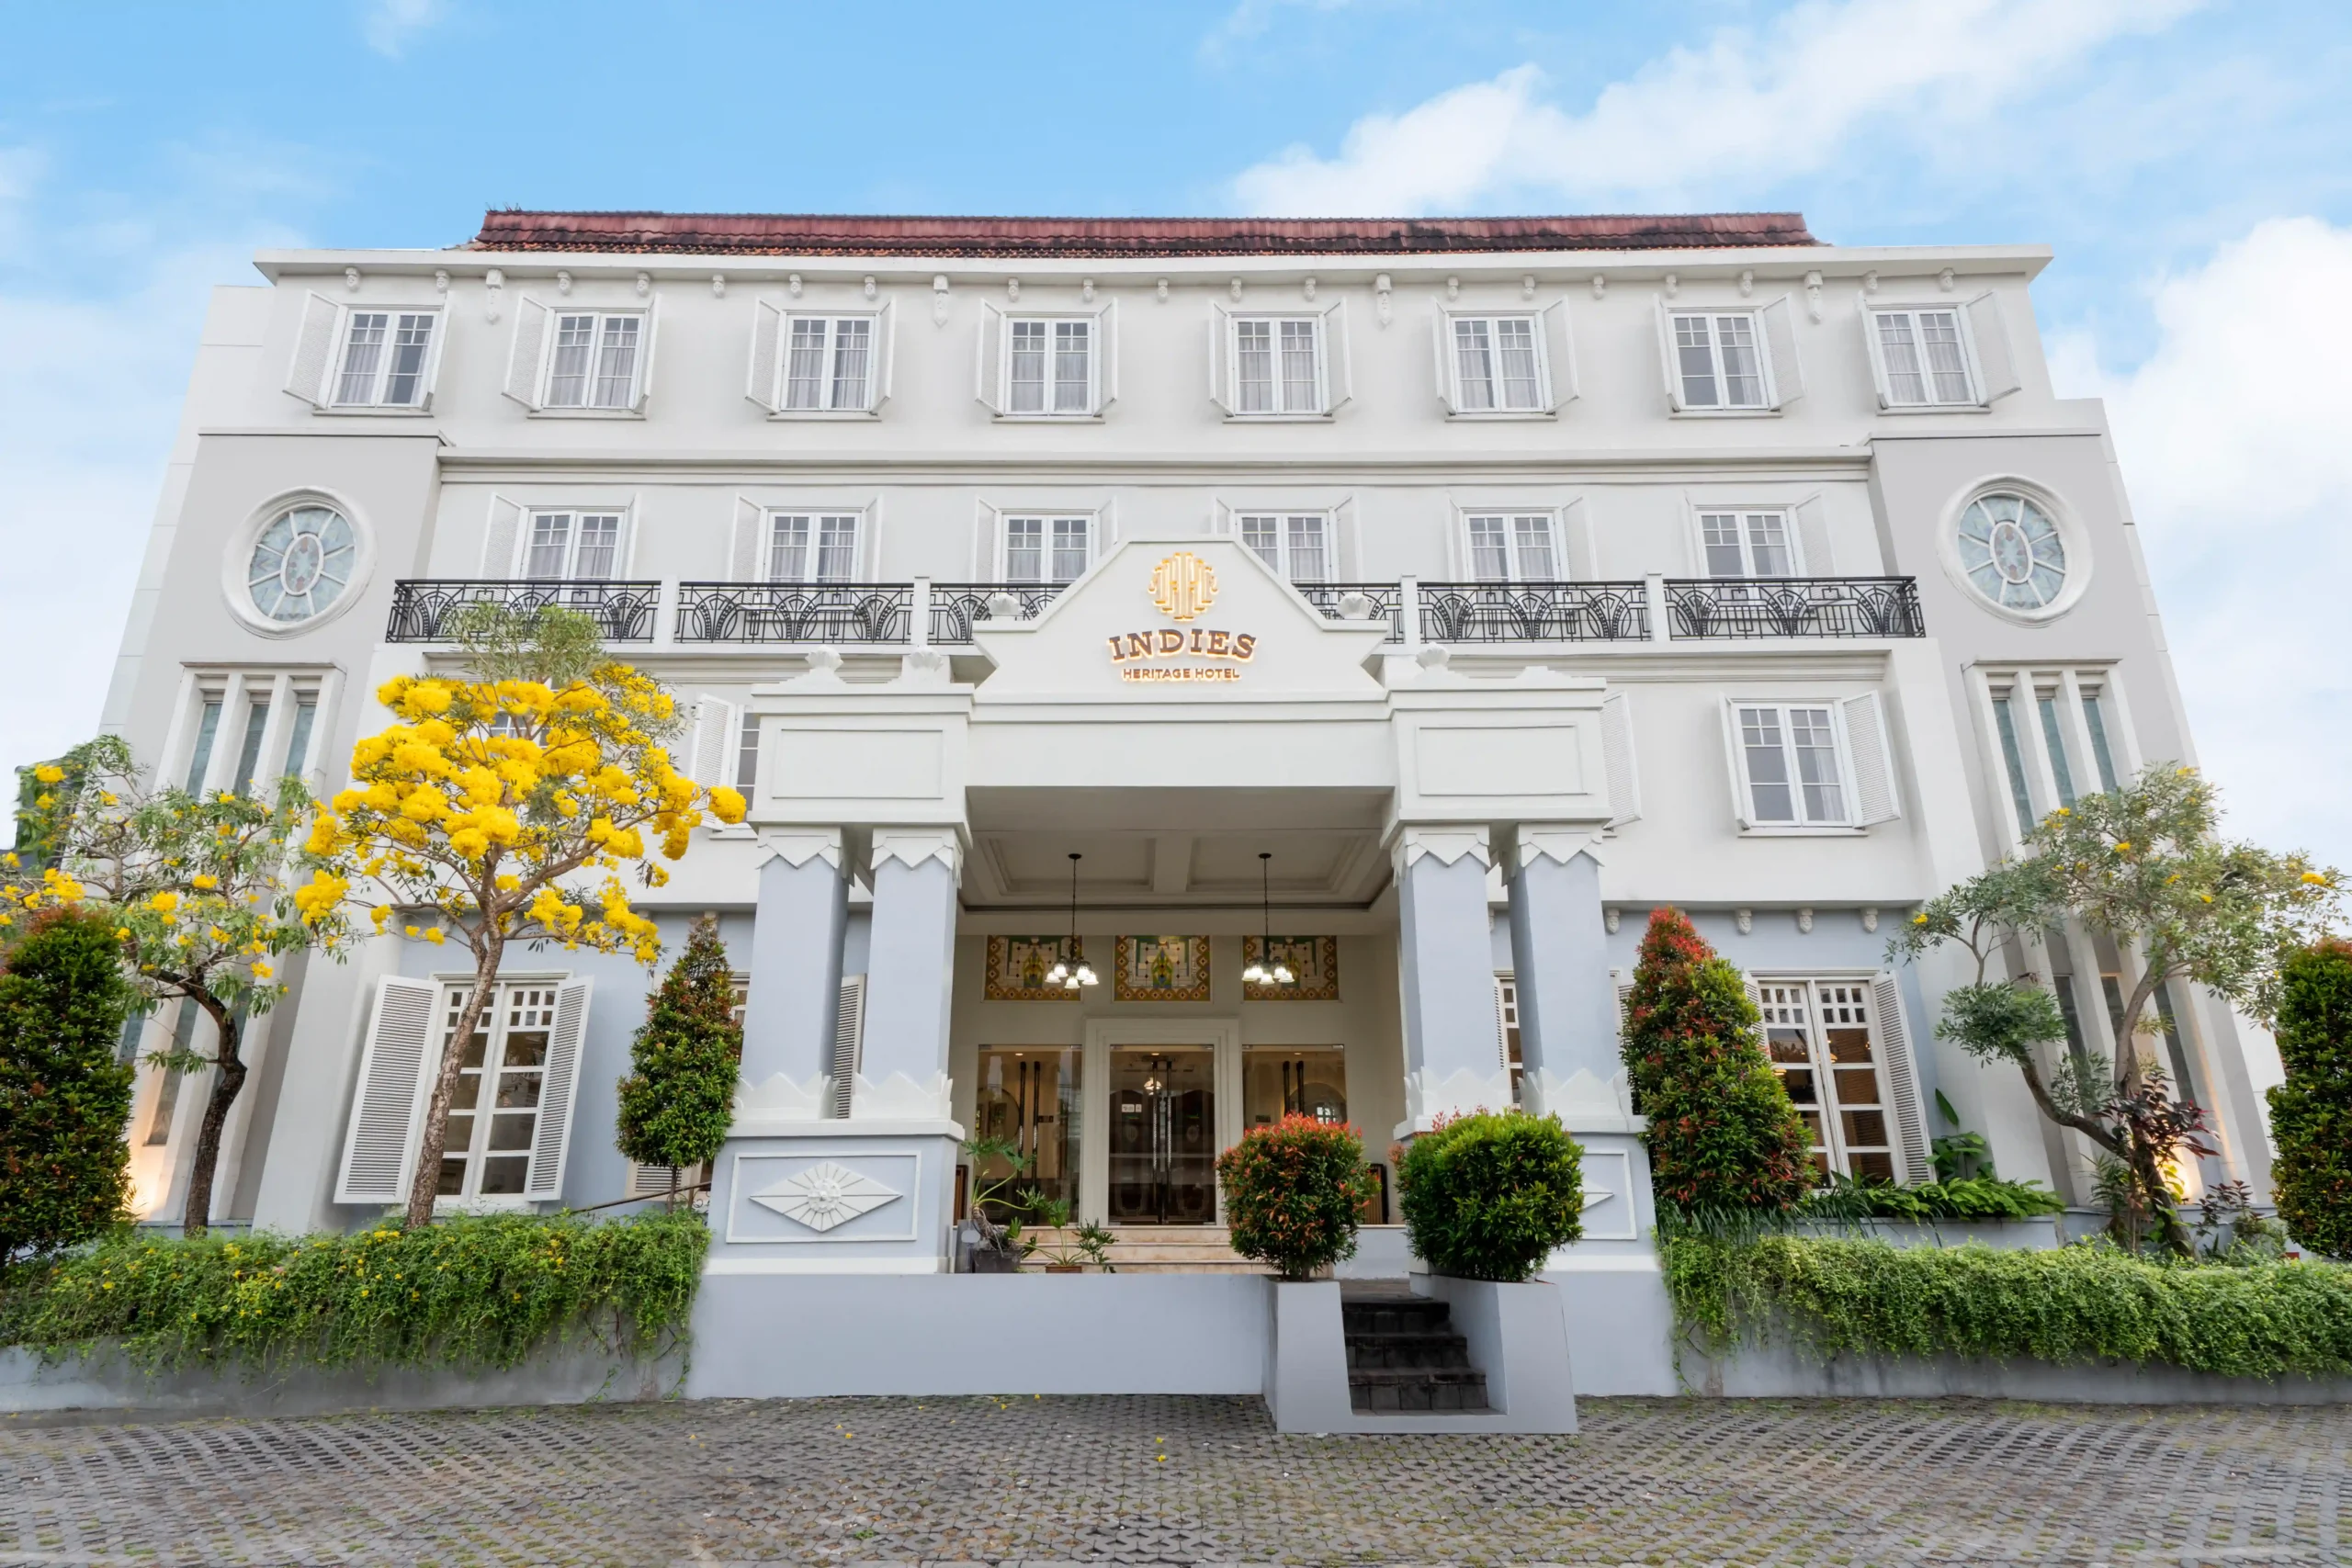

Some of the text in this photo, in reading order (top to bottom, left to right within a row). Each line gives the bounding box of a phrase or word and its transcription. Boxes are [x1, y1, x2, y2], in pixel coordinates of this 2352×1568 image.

[1109, 627, 1257, 661] INDIES
[1123, 668, 1240, 679] HERITAGE HOTEL
